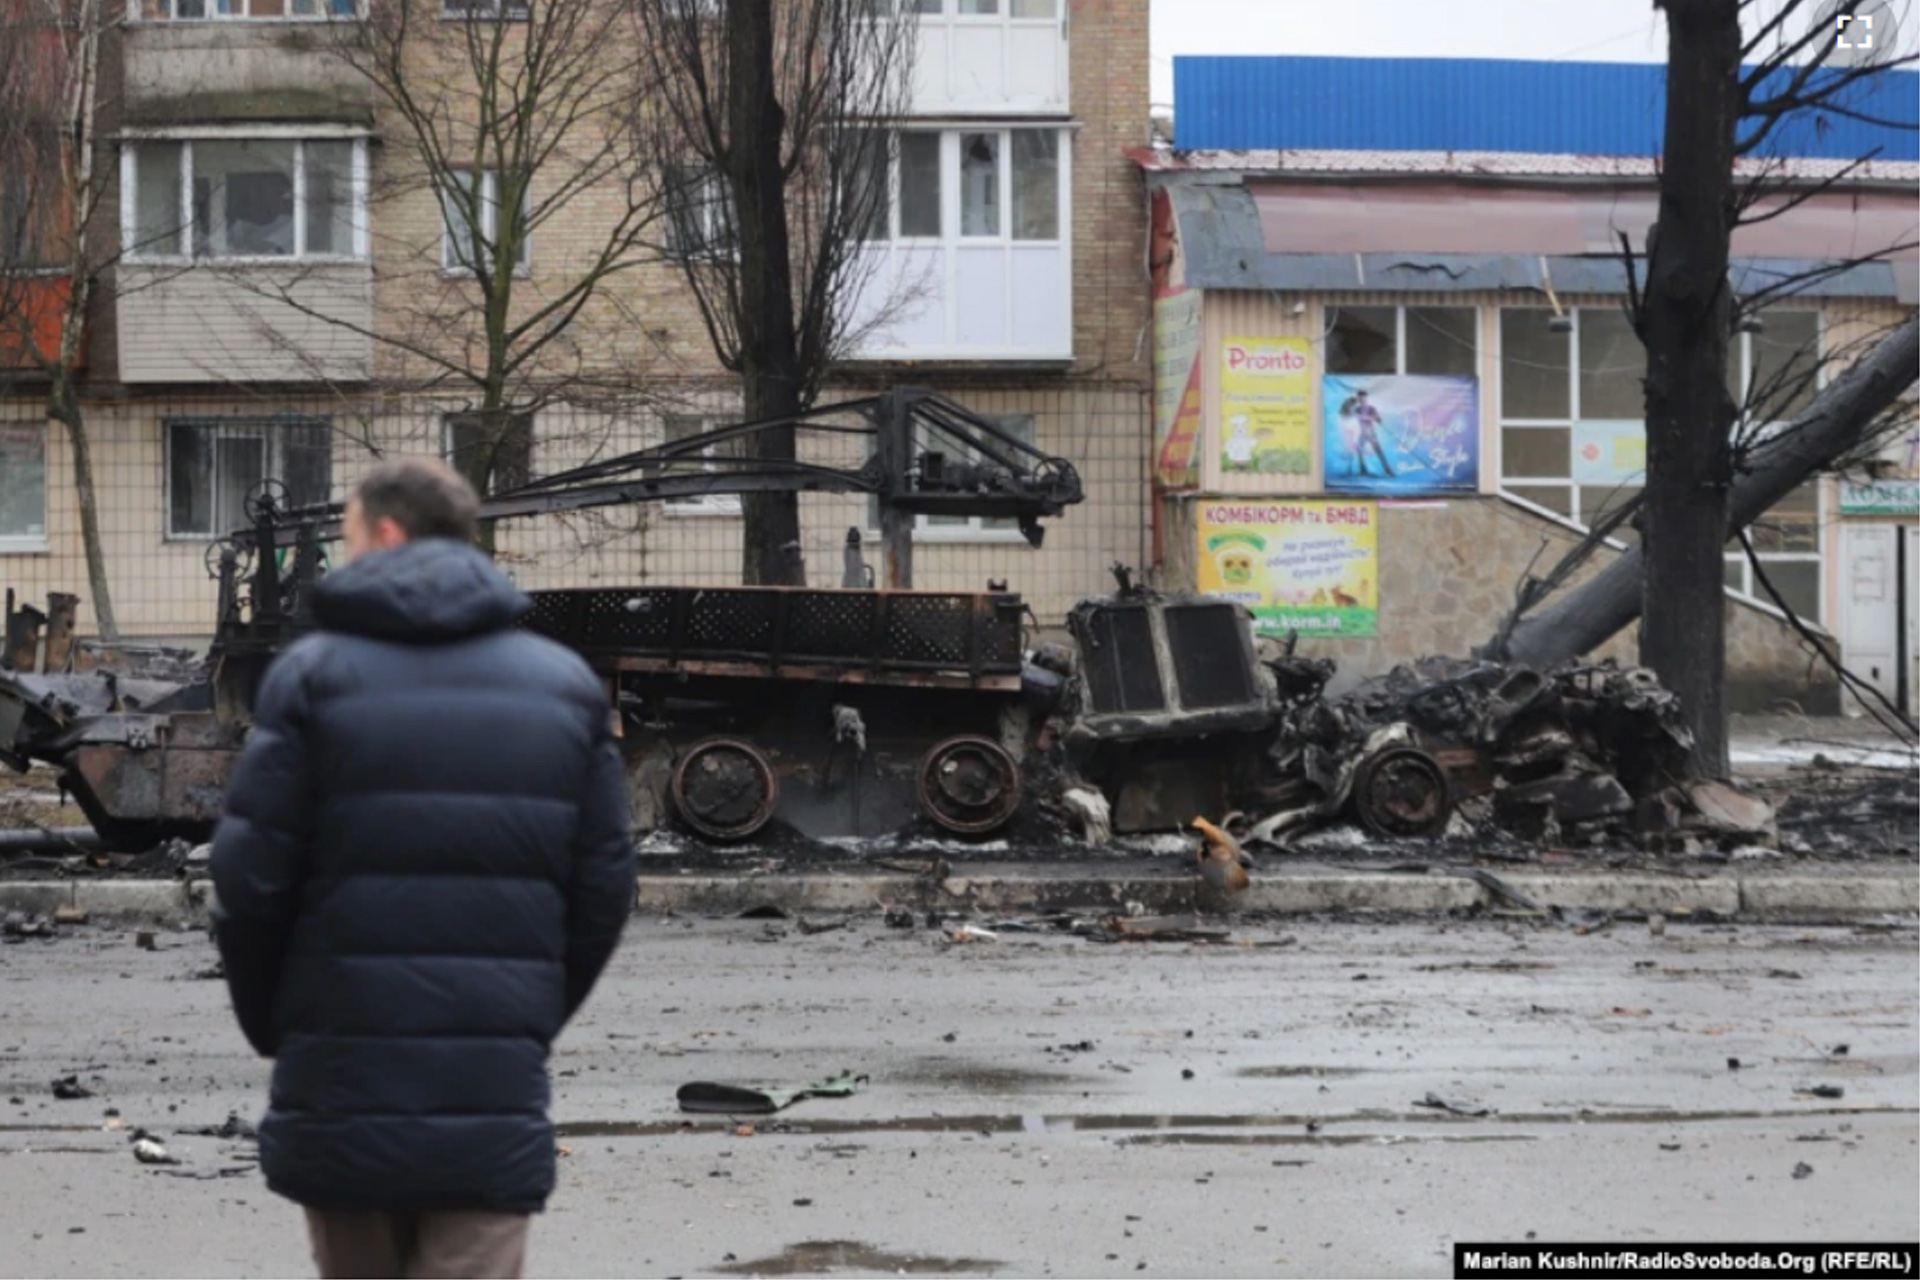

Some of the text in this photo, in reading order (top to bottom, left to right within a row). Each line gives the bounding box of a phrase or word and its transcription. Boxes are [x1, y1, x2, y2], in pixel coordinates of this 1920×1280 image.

[1228, 347, 1305, 369] Pronto
[1206, 505, 1303, 524] КОМБІКОРМ
[1326, 505, 1370, 525] БМВД
